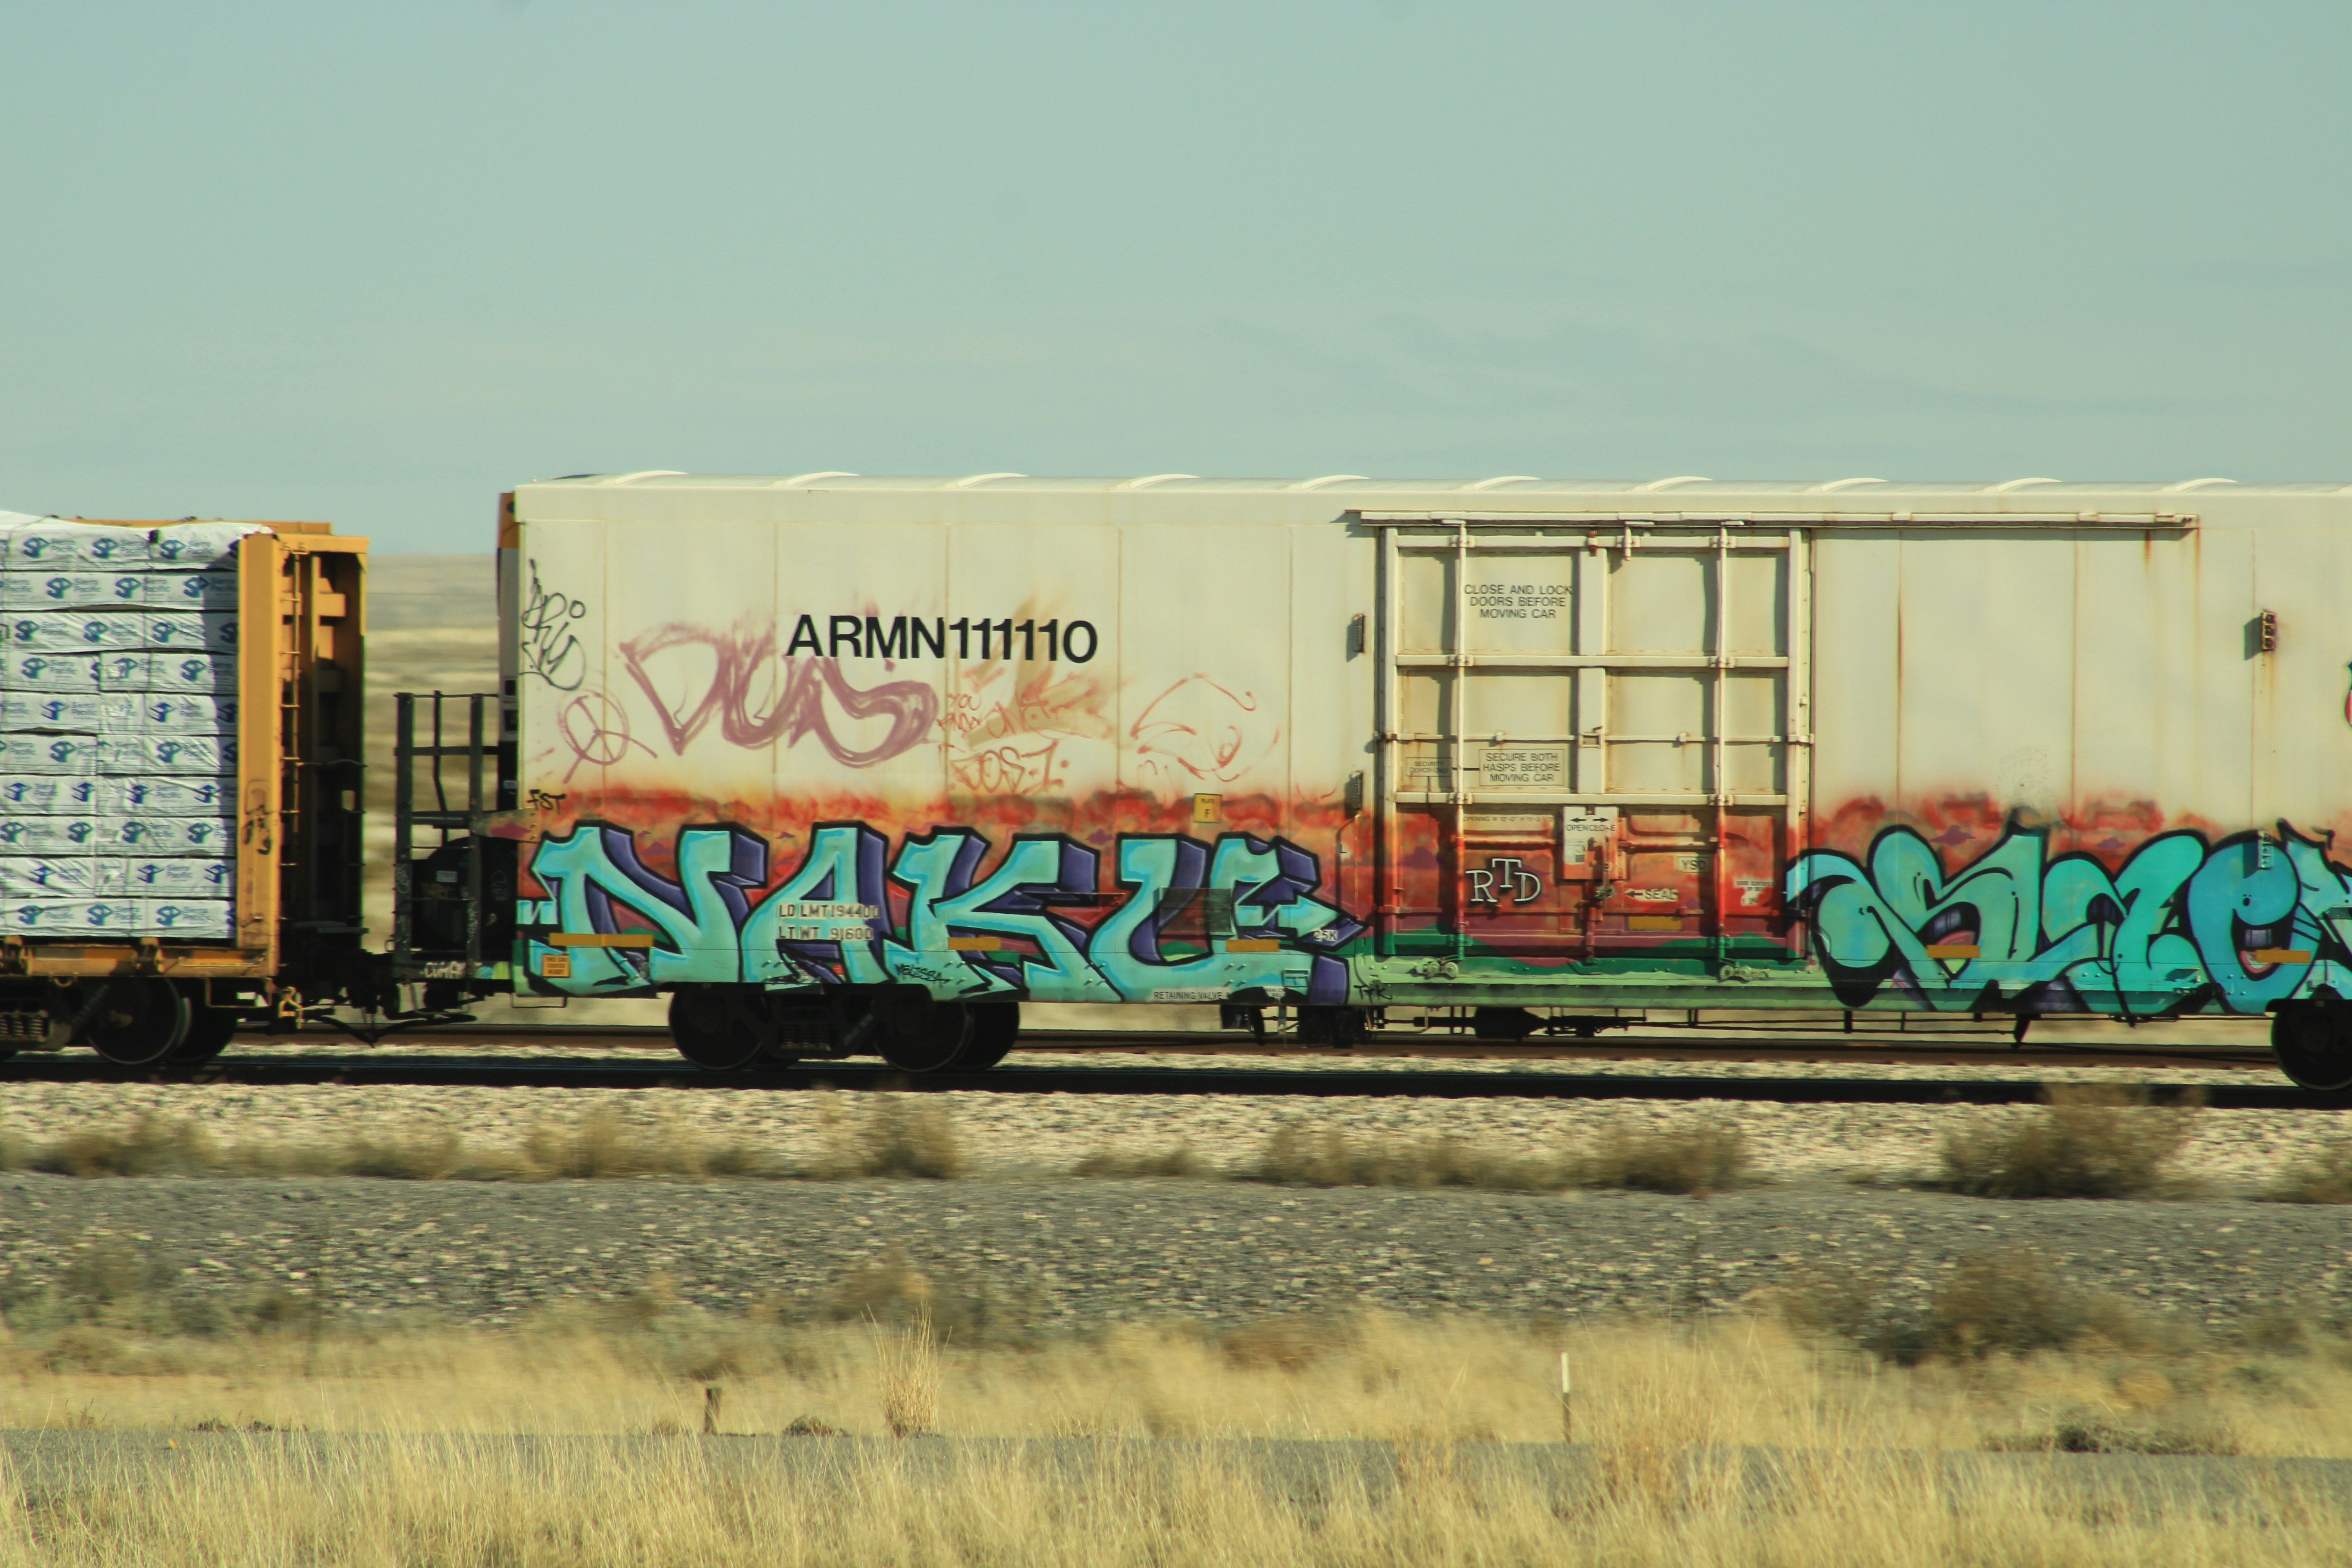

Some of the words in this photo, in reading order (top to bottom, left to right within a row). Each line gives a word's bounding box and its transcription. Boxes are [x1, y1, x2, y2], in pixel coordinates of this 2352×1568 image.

[1465, 584, 1504, 594] CLOSE
[1510, 585, 1535, 594] AND
[1540, 585, 1573, 595] LOCK
[1470, 596, 1513, 606] DOORS
[1518, 597, 1566, 606] BEFORE
[1480, 608, 1526, 618] MOVING
[1532, 609, 1556, 618] CAR
[1486, 753, 1526, 761] SECURE
[1531, 753, 1558, 762] BOTH
[1483, 763, 1517, 771] HASPS
[1521, 763, 1561, 771] BEFORE
[1204, 809, 1210, 818] F
[779, 904, 795, 917] LD
[800, 904, 828, 917] LMT
[831, 905, 880, 917] 194400
[779, 926, 795, 938] LT
[799, 926, 819, 939] WT
[831, 927, 873, 940] 91600
[1154, 991, 1196, 1000] RETAINING
[1199, 992, 1222, 1000] VALVE
